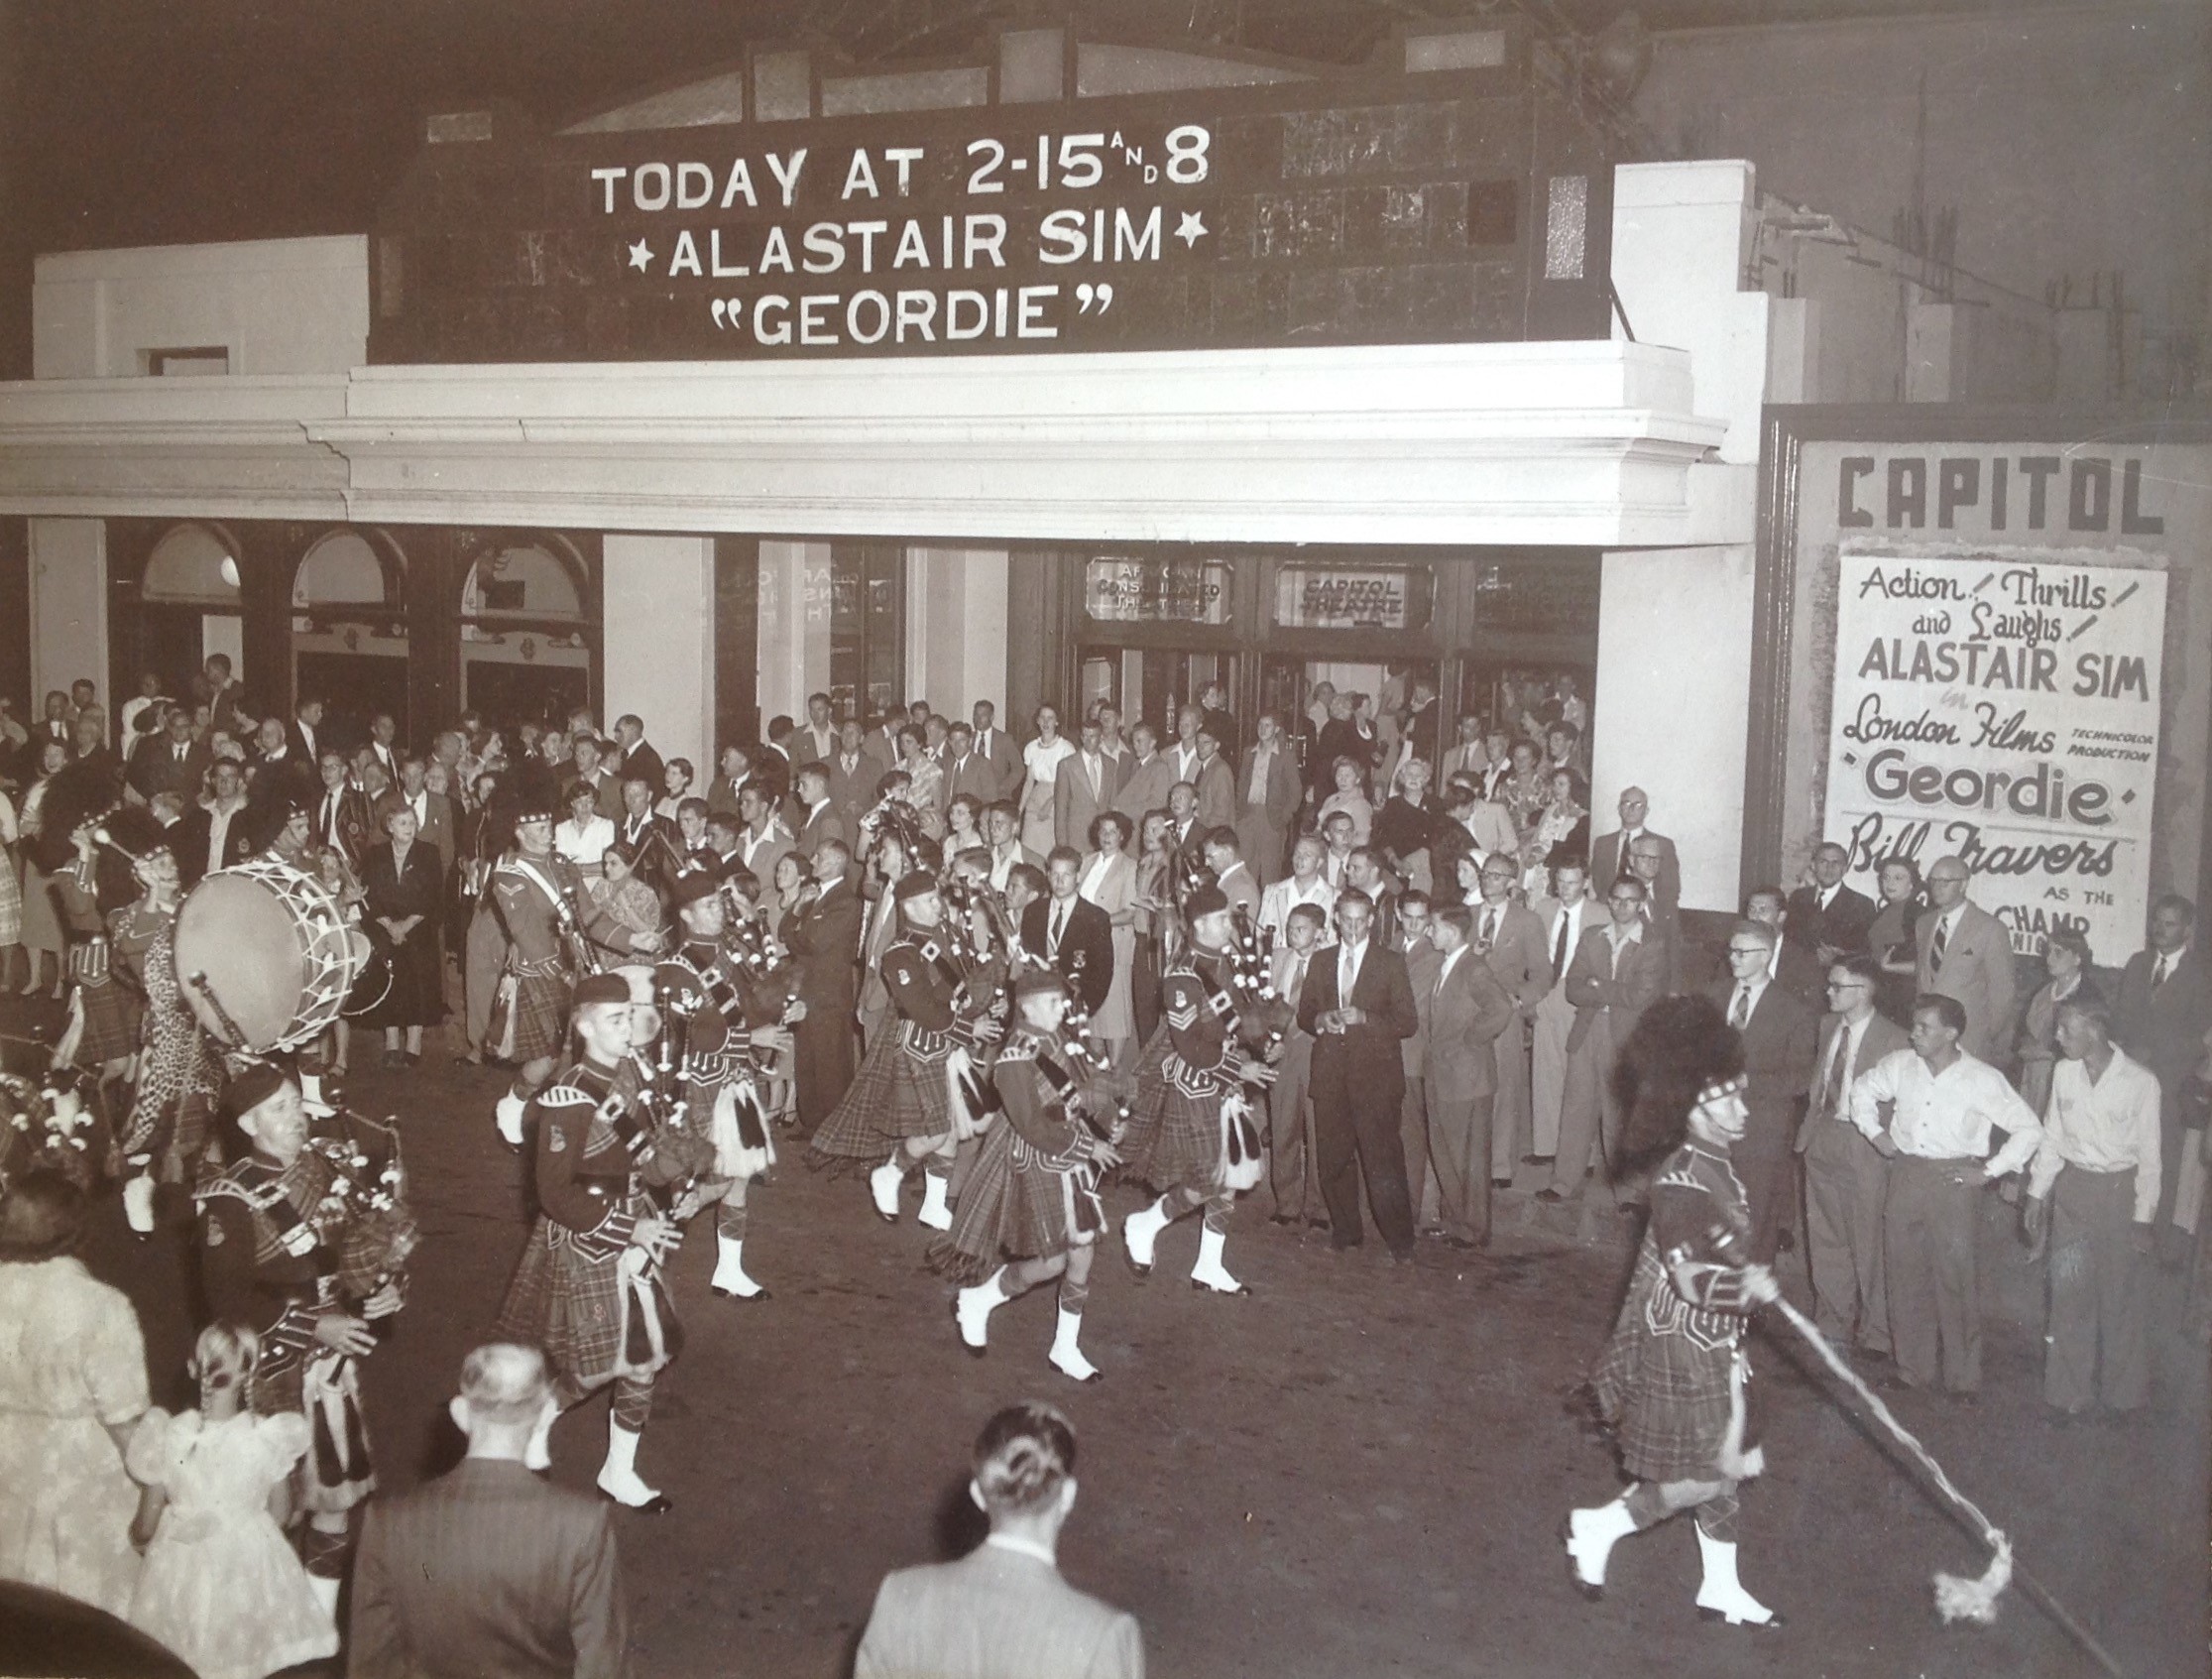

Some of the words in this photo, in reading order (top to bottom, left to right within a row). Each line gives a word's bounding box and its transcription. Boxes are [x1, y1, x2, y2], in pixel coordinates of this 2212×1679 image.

[591, 148, 808, 213] TODAY
[841, 147, 924, 200] AT
[966, 133, 1105, 194] 2-15
[1165, 125, 1211, 183] 8
[668, 213, 1007, 278] ALASTAIR
[1038, 206, 1162, 265] SIM
[1838, 456, 2164, 535] CAPITOL
[1306, 579, 1400, 595] CAPITOL
[1912, 610, 1951, 635] and
[1858, 637, 2058, 692] ALASTAIR
[2072, 652, 2151, 702] SIM
[1842, 692, 1960, 744] London
[1970, 701, 2056, 754] Films
[2067, 744, 2151, 762] PRODUCTION
[1864, 747, 2113, 826] Geordie
[1846, 811, 1931, 873] Bill
[1943, 820, 2118, 878] Travers
[2043, 886, 2070, 900] AS
[2083, 891, 2115, 905] THE
